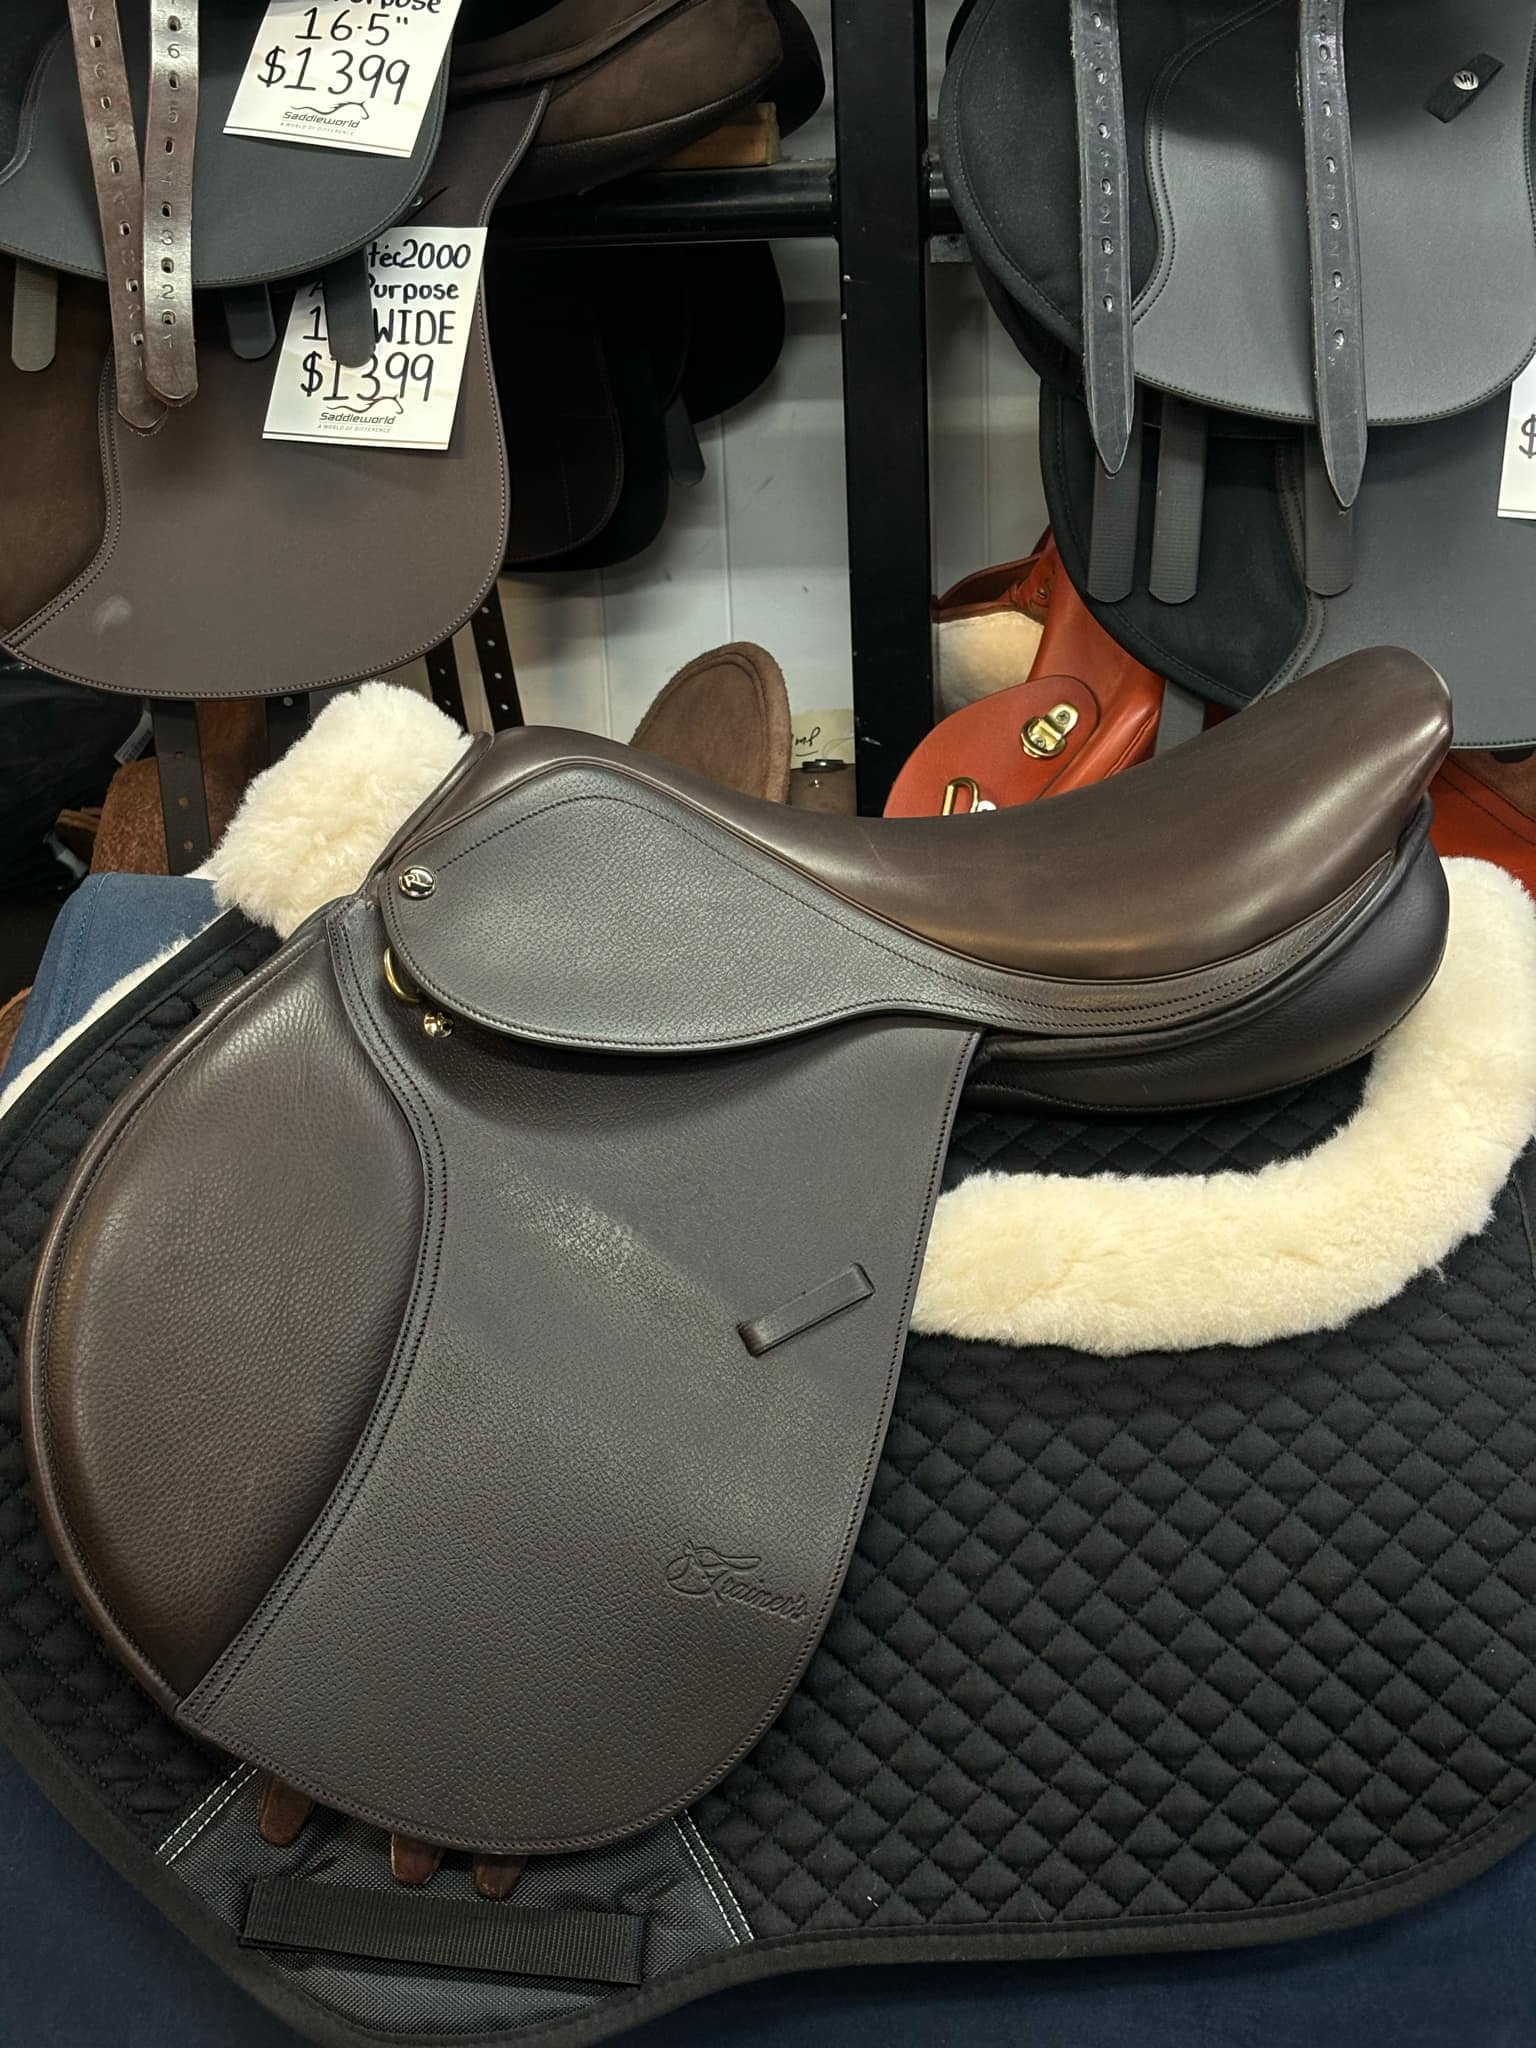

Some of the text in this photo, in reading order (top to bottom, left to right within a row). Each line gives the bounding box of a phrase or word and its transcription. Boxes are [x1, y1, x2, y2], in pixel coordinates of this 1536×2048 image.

[167, 43, 180, 59] 6
[257, 46, 410, 105] $1399
[282, 111, 361, 128] Saddleworld
[161, 284, 175, 300] 2
[374, 308, 456, 345] WIDE
[300, 351, 434, 402] $1399
[319, 412, 397, 425] Saddleworld
